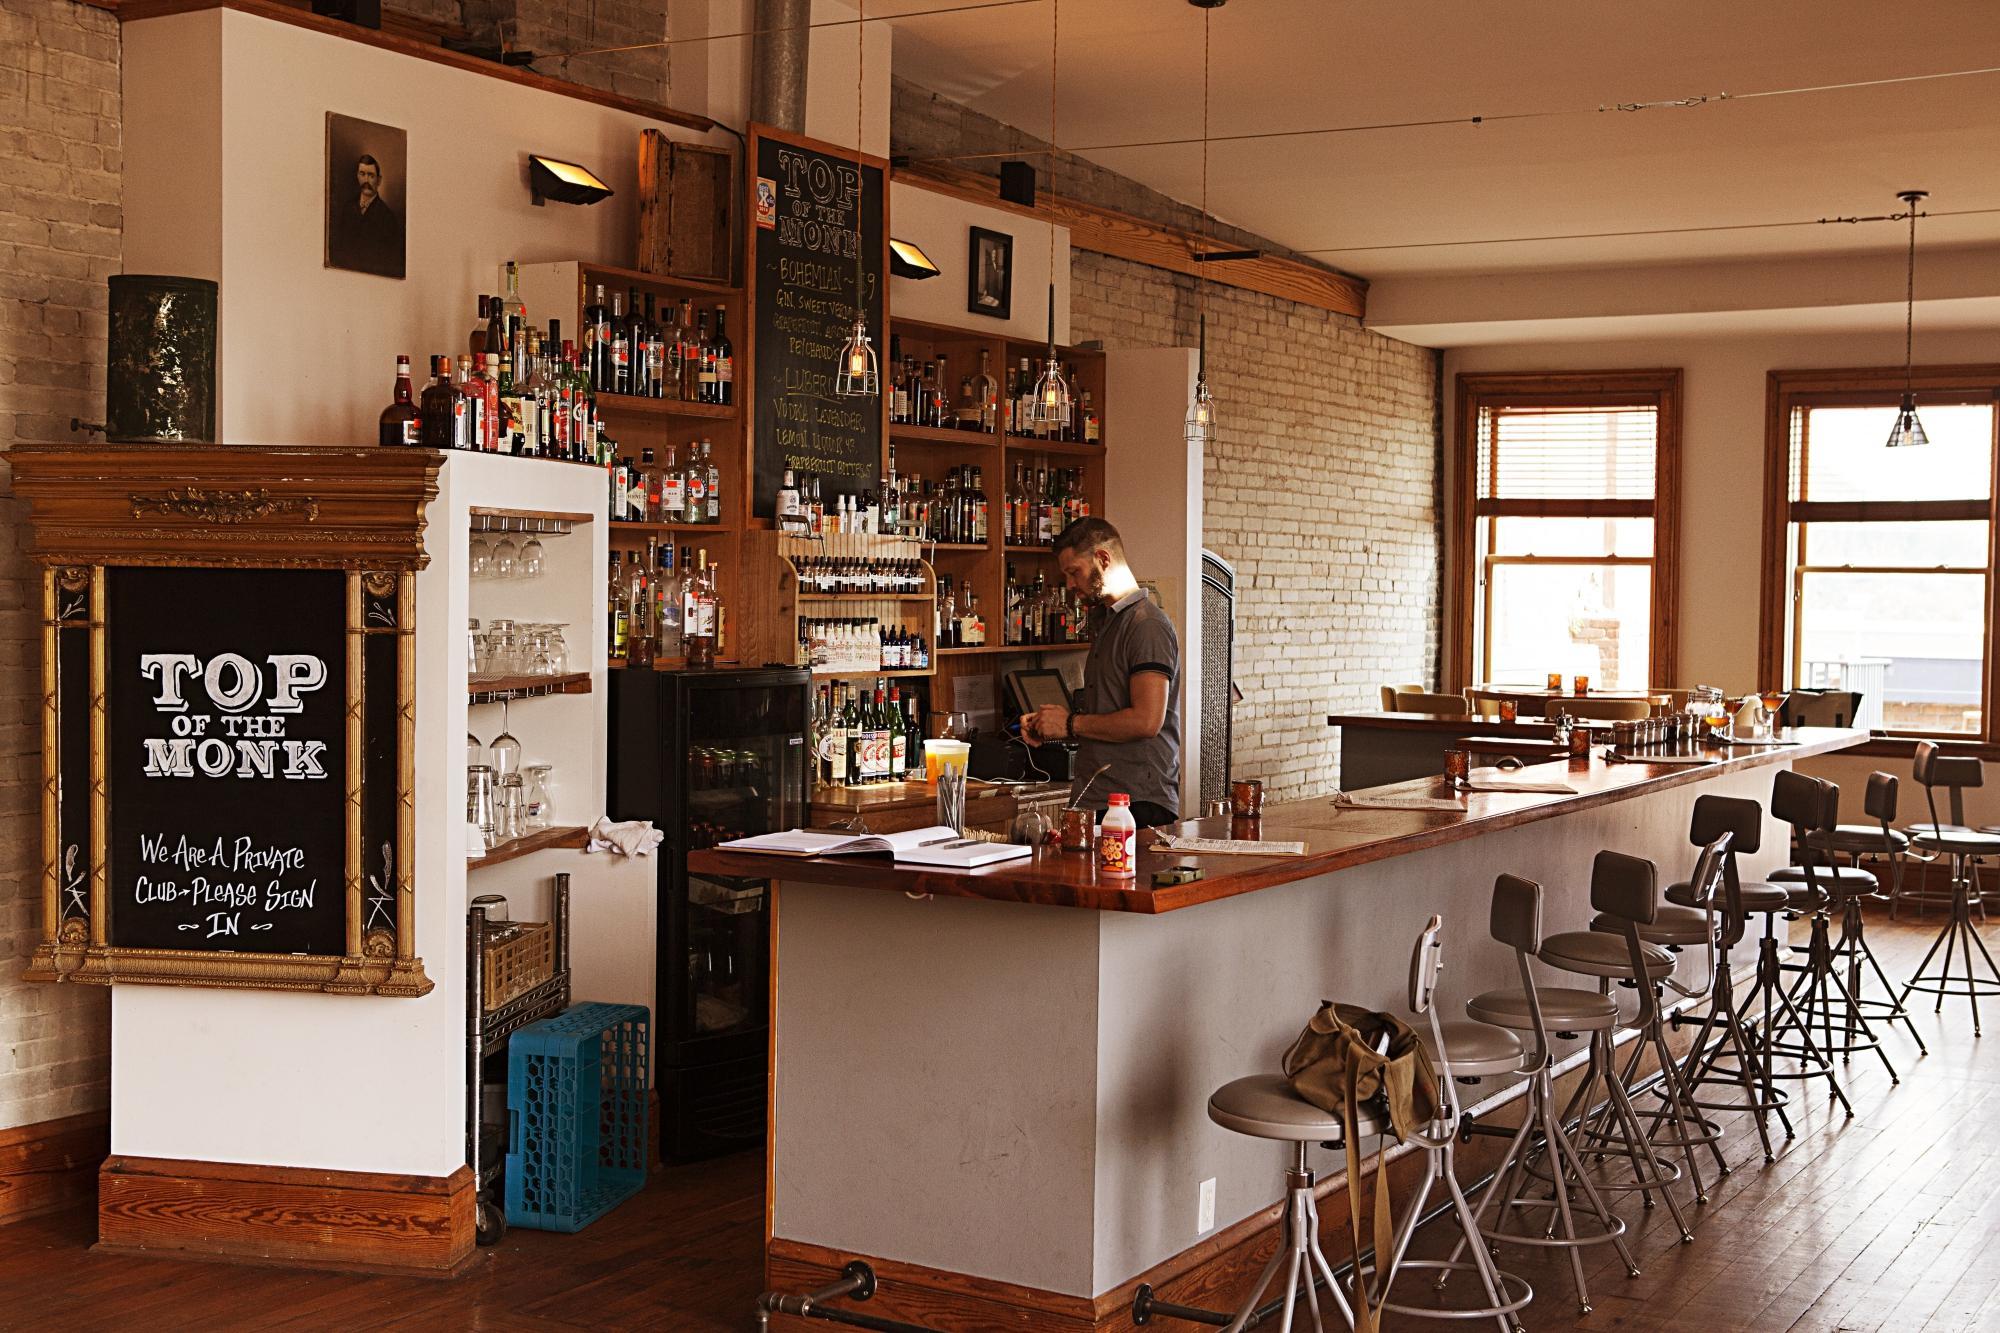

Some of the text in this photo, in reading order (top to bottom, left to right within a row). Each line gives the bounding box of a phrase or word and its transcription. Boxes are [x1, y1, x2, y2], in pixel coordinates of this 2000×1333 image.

[778, 150, 863, 211] TOP
[792, 200, 812, 217] OF
[140, 652, 328, 714] TOP
[171, 714, 286, 738] OF THE
[142, 738, 329, 780] MONK
[140, 832, 169, 864] We
[208, 836, 230, 868] A
